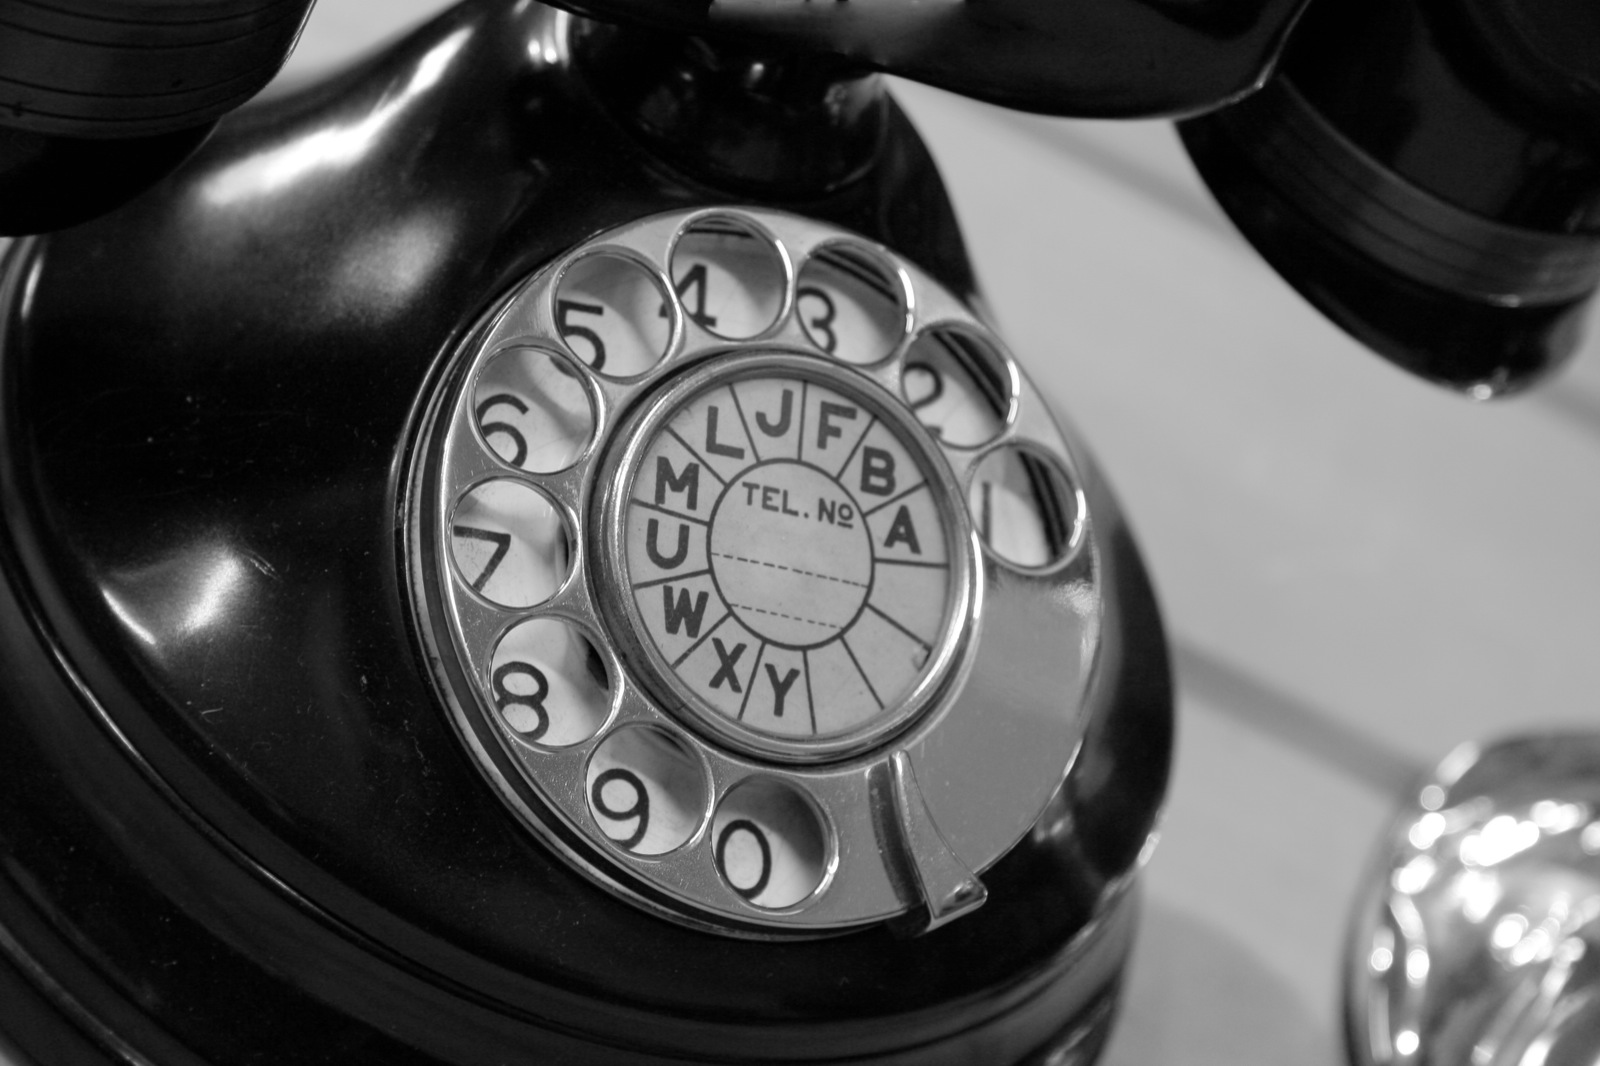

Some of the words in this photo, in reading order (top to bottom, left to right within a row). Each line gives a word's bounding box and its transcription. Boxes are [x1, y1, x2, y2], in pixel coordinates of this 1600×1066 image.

[659, 264, 717, 328] 4
[799, 287, 838, 355] 3
[556, 299, 606, 372] 5
[755, 389, 794, 437] J
[817, 401, 857, 449] F
[903, 362, 943, 436] 2
[476, 394, 529, 468] 6
[705, 405, 745, 460] L
[654, 456, 700, 511] M
[860, 446, 897, 497] B
[742, 481, 809, 519] TEL.
[645, 518, 690, 570] U
[883, 505, 922, 555] A
[453, 525, 511, 592] 7
[663, 585, 709, 639] W
[708, 637, 748, 694] X
[764, 663, 800, 717] Y
[492, 661, 549, 742] 8
[591, 768, 649, 851] 9
[716, 819, 772, 901] 0
